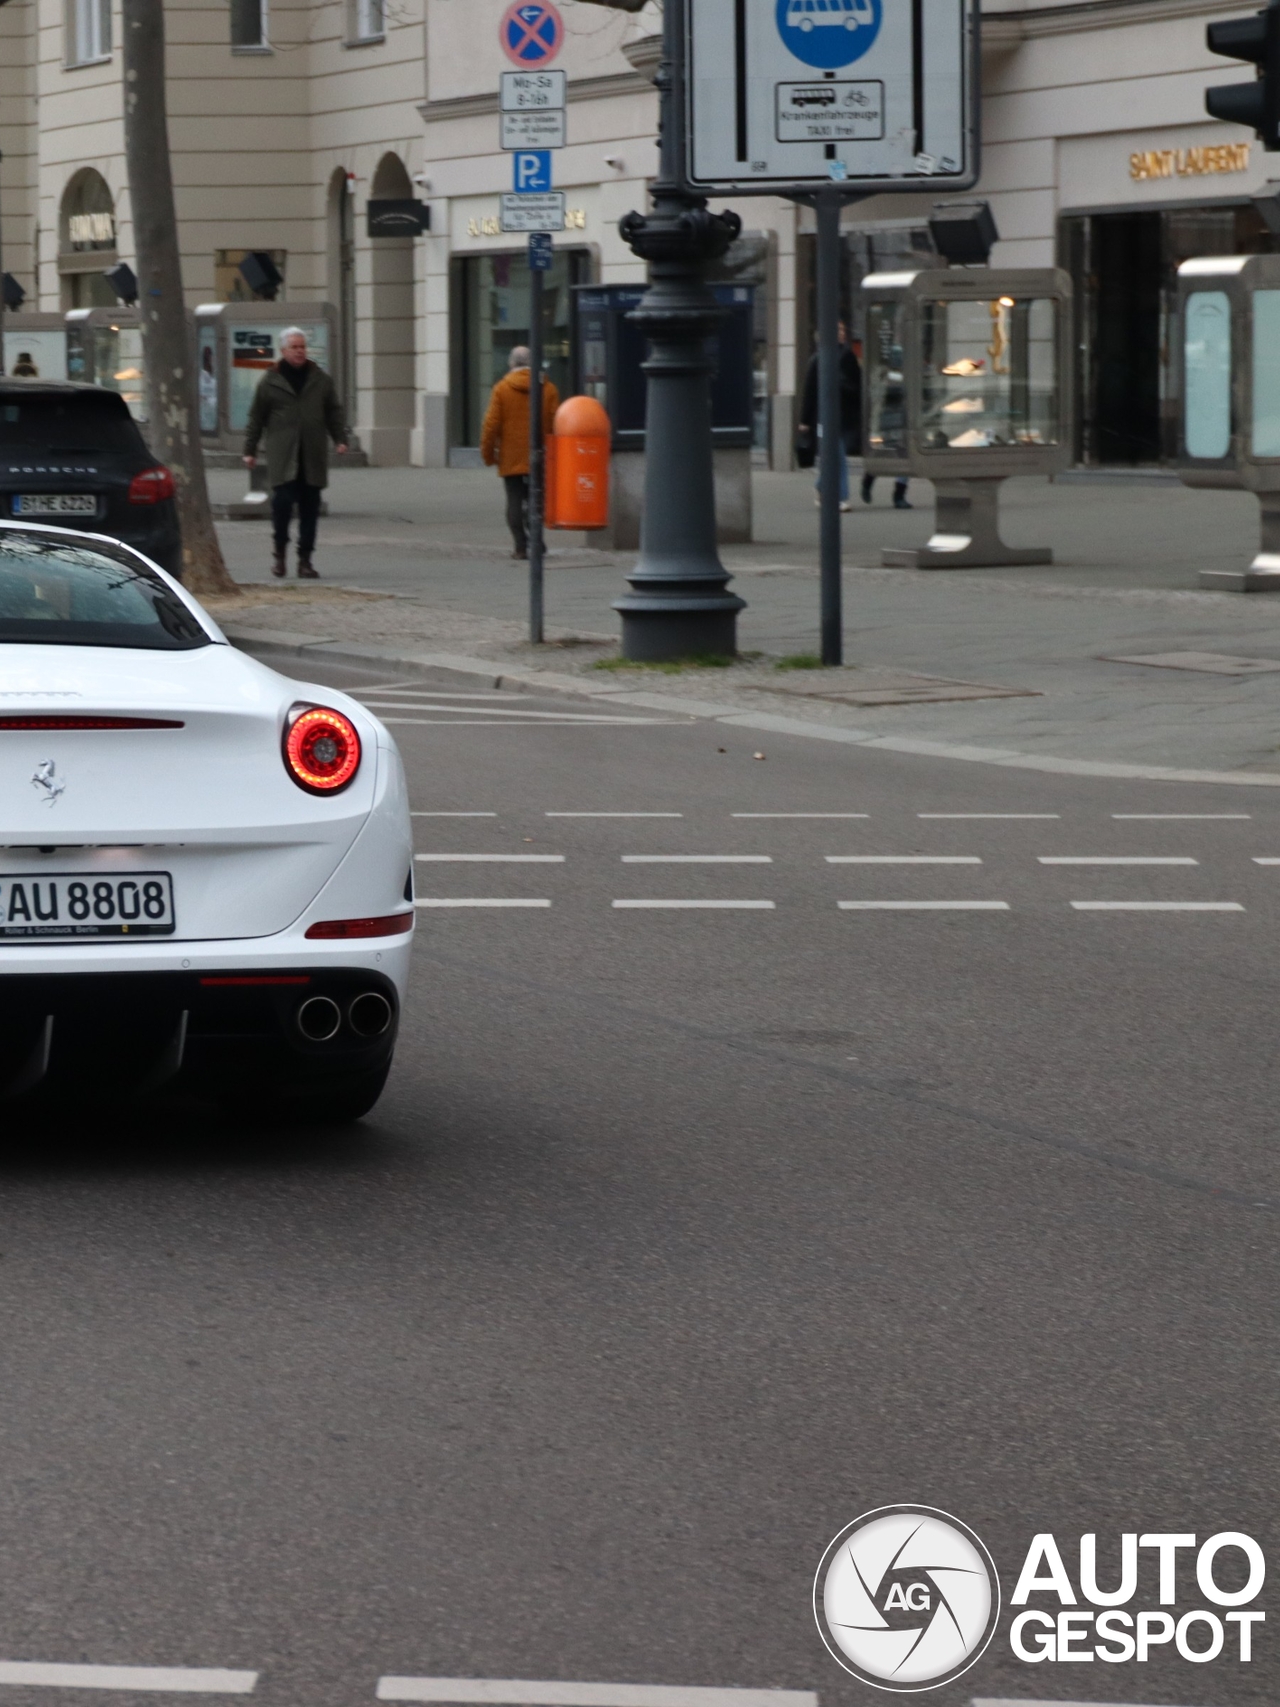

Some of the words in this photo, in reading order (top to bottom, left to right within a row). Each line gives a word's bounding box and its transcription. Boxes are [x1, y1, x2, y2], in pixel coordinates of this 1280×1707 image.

[517, 154, 541, 189] P
[1130, 150, 1174, 181] SAINT
[1175, 143, 1251, 178] LAURENT
[7, 882, 59, 922] AU
[67, 880, 166, 921] 8808
[76, 925, 99, 934] Berlin
